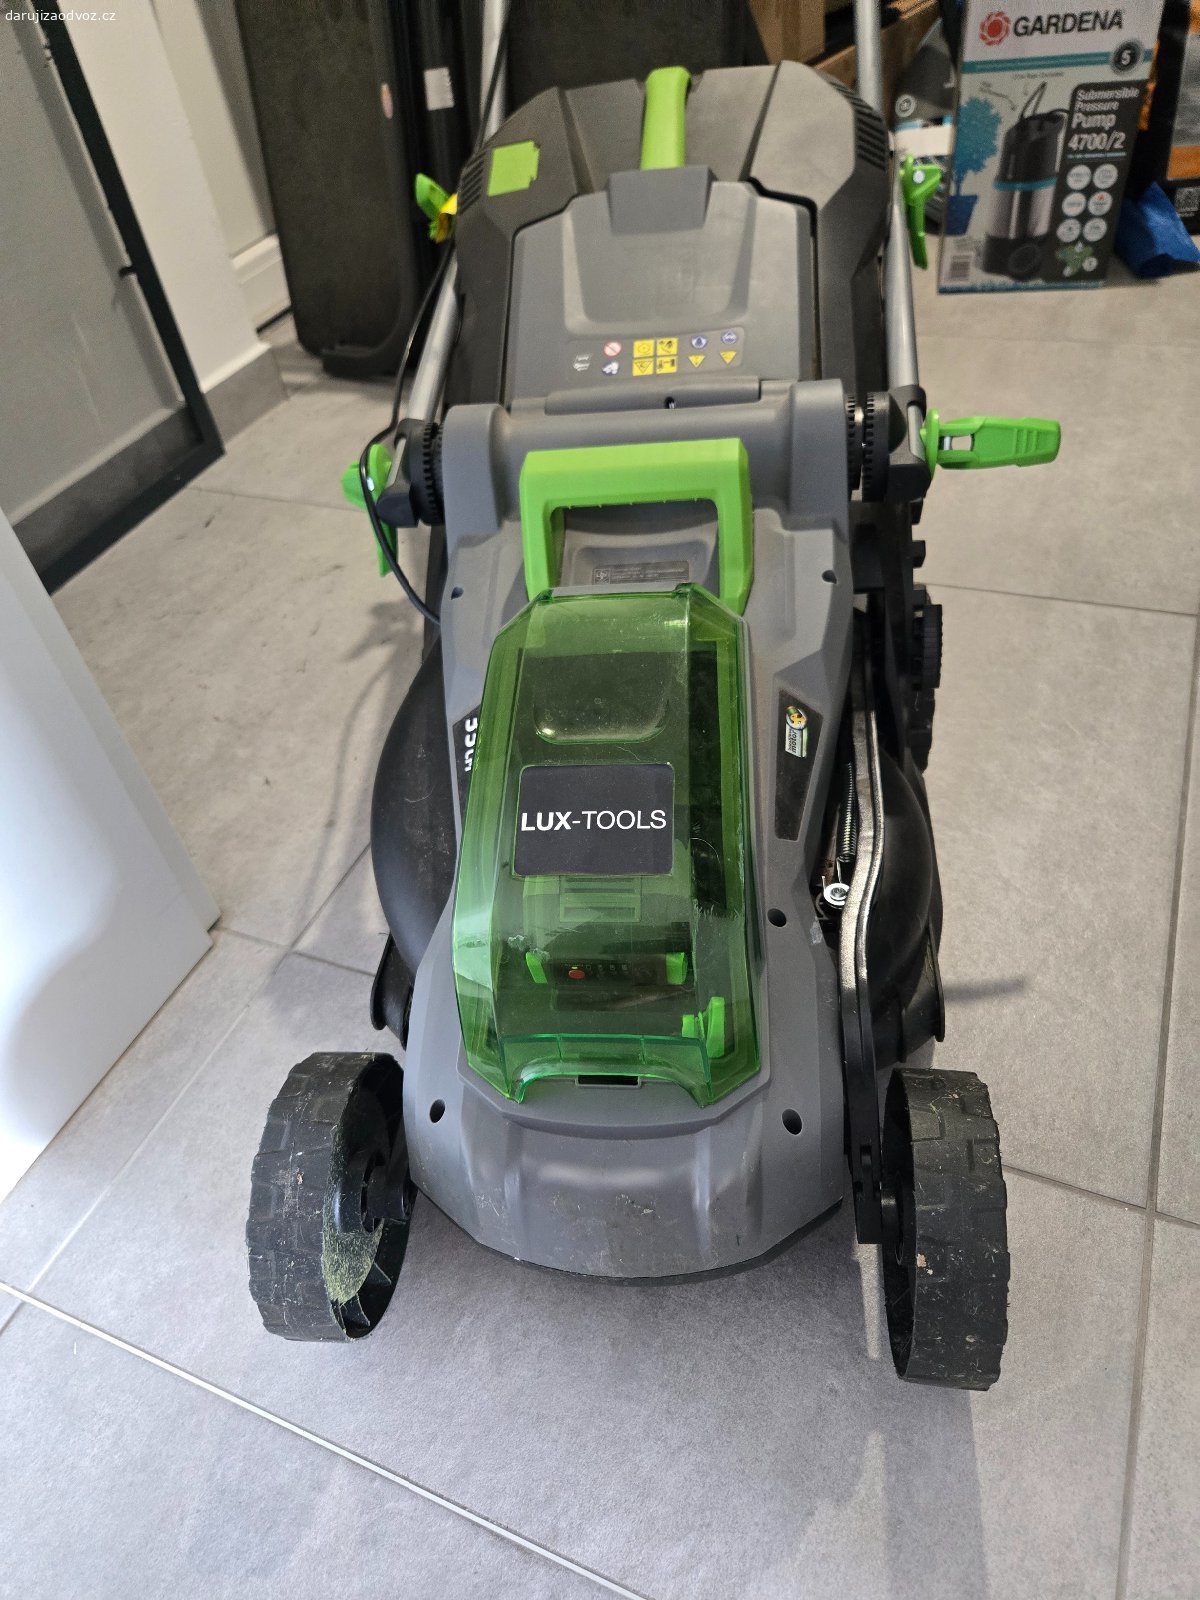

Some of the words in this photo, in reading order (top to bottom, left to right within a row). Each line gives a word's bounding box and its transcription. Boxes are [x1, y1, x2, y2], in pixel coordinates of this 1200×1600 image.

[1013, 9, 1123, 37] GARDENA
[1071, 112, 1116, 131] Pump
[1068, 131, 1126, 151] 4700/2
[521, 809, 667, 832] LUX-TOOLS
